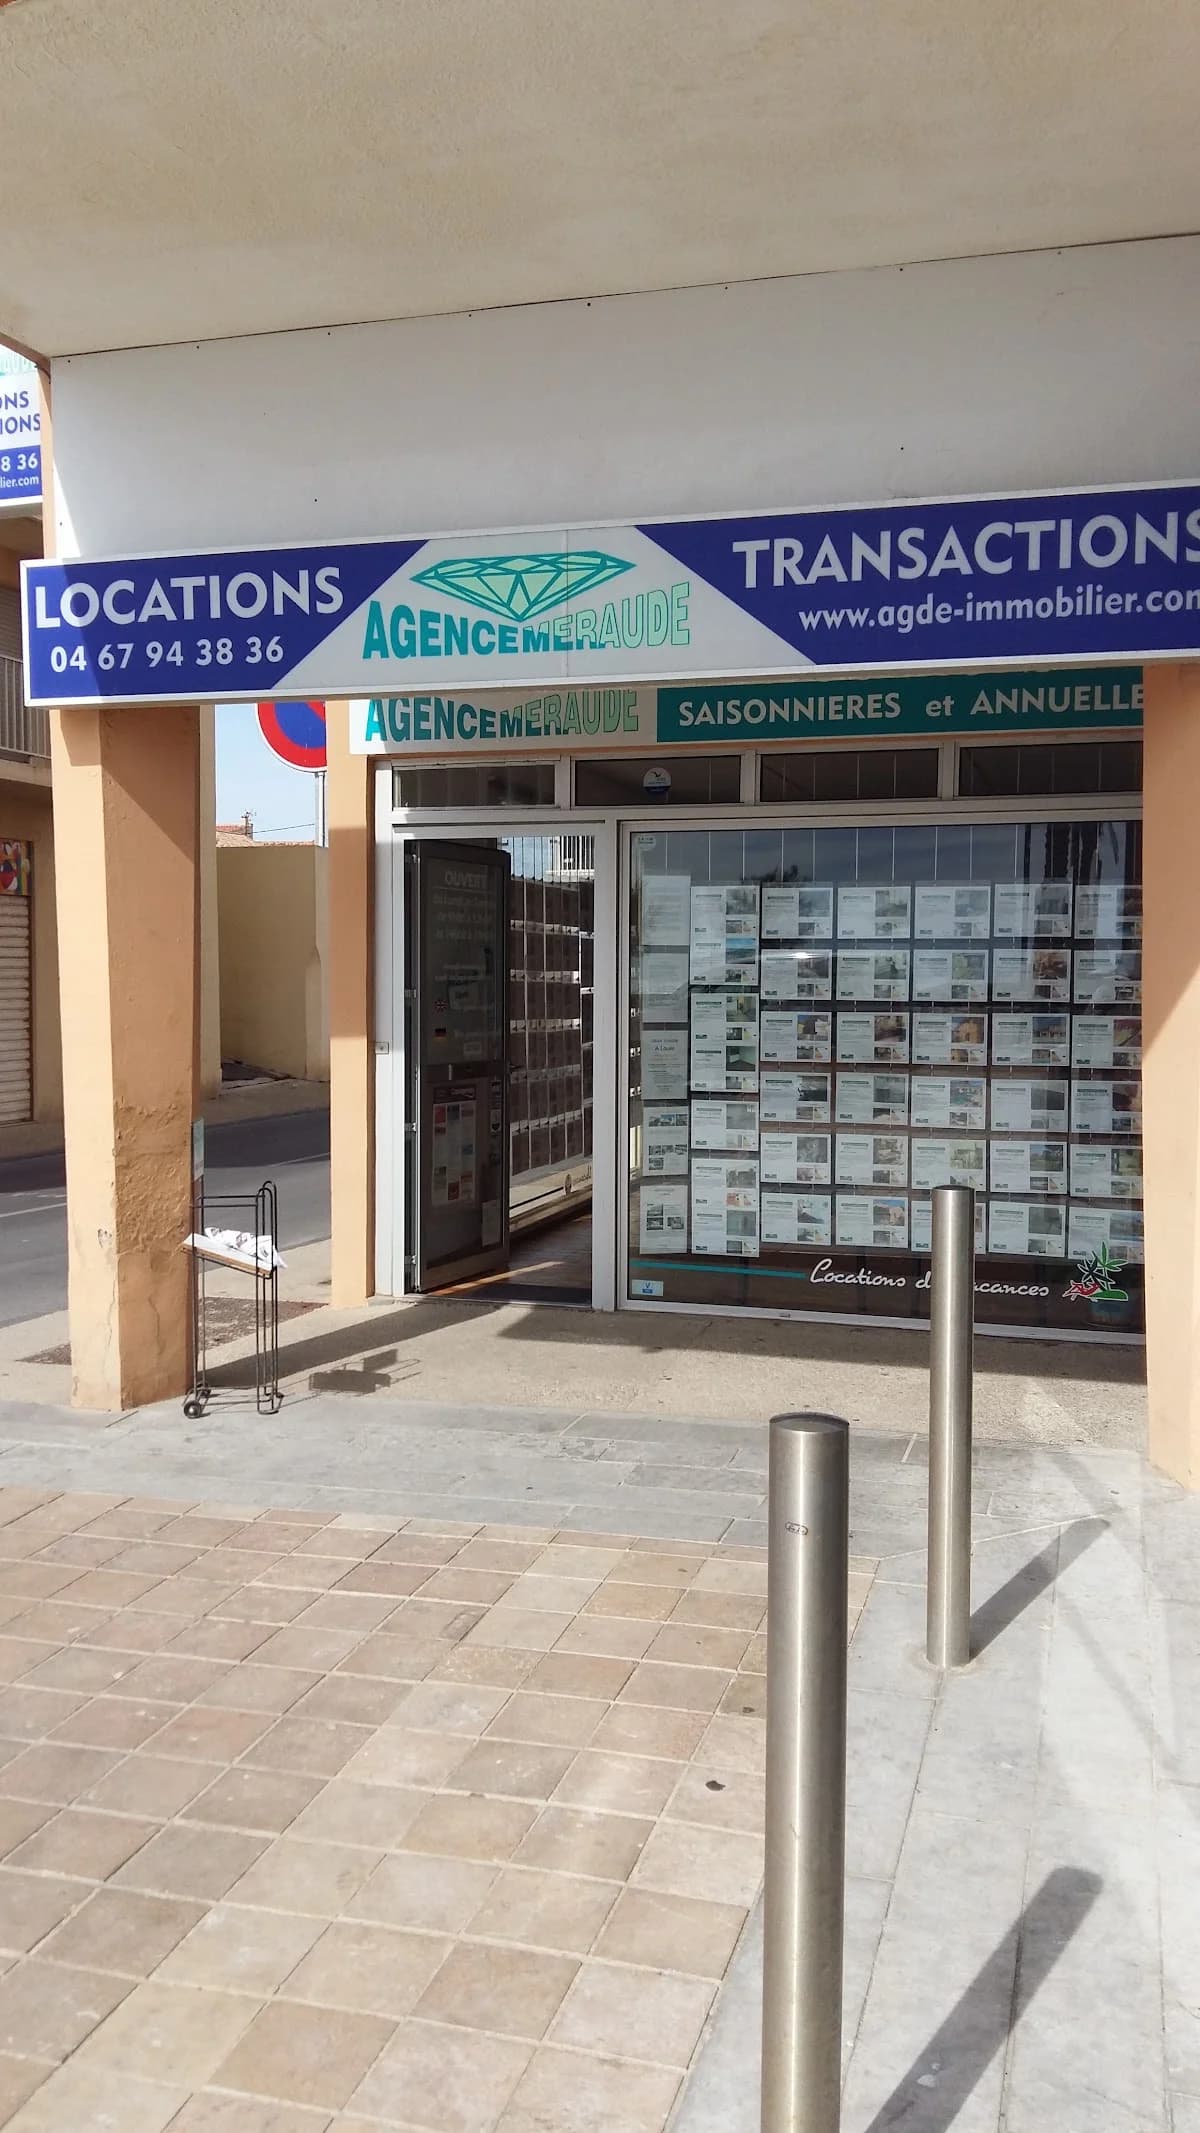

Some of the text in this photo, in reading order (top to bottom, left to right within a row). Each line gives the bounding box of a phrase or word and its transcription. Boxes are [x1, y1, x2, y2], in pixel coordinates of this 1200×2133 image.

[0, 391, 29, 410] NS
[17, 453, 38, 470] 36
[35, 566, 344, 629] LOCATIONS
[50, 636, 284, 673] 04 67 94 38 36
[679, 684, 1144, 727] SAISONNIERES et ANNUELLE
[810, 1258, 1049, 1297] Locations d cances
